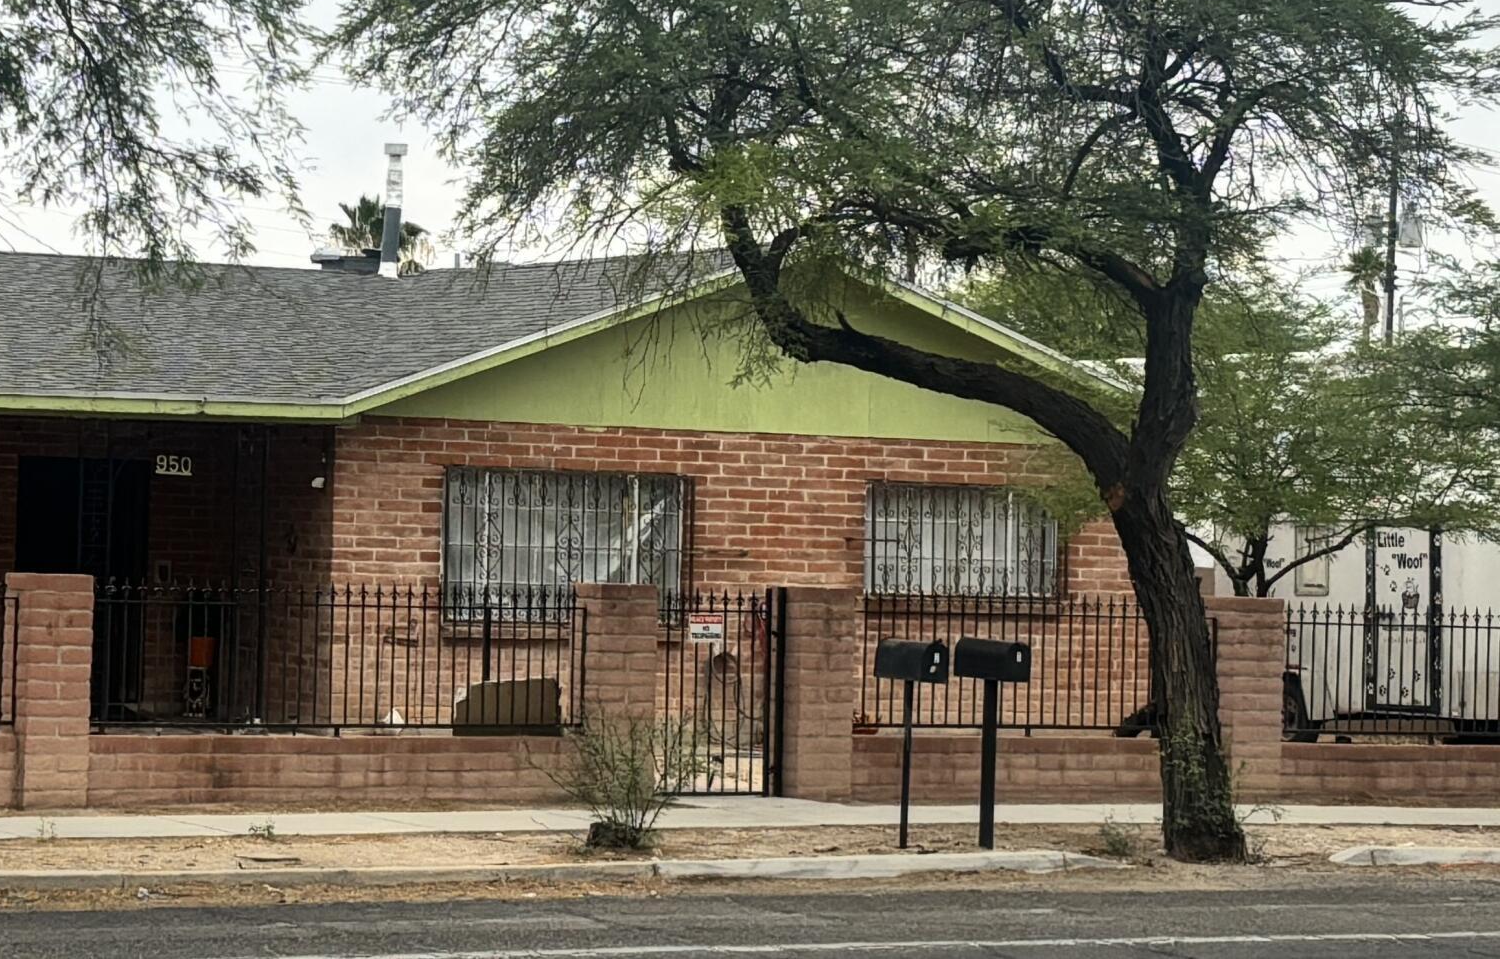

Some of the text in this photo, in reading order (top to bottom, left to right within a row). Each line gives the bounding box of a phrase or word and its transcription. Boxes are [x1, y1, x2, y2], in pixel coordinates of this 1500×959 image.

[156, 455, 192, 473] 950
[1377, 532, 1405, 548] Little
[1392, 553, 1428, 569] "Woof"
